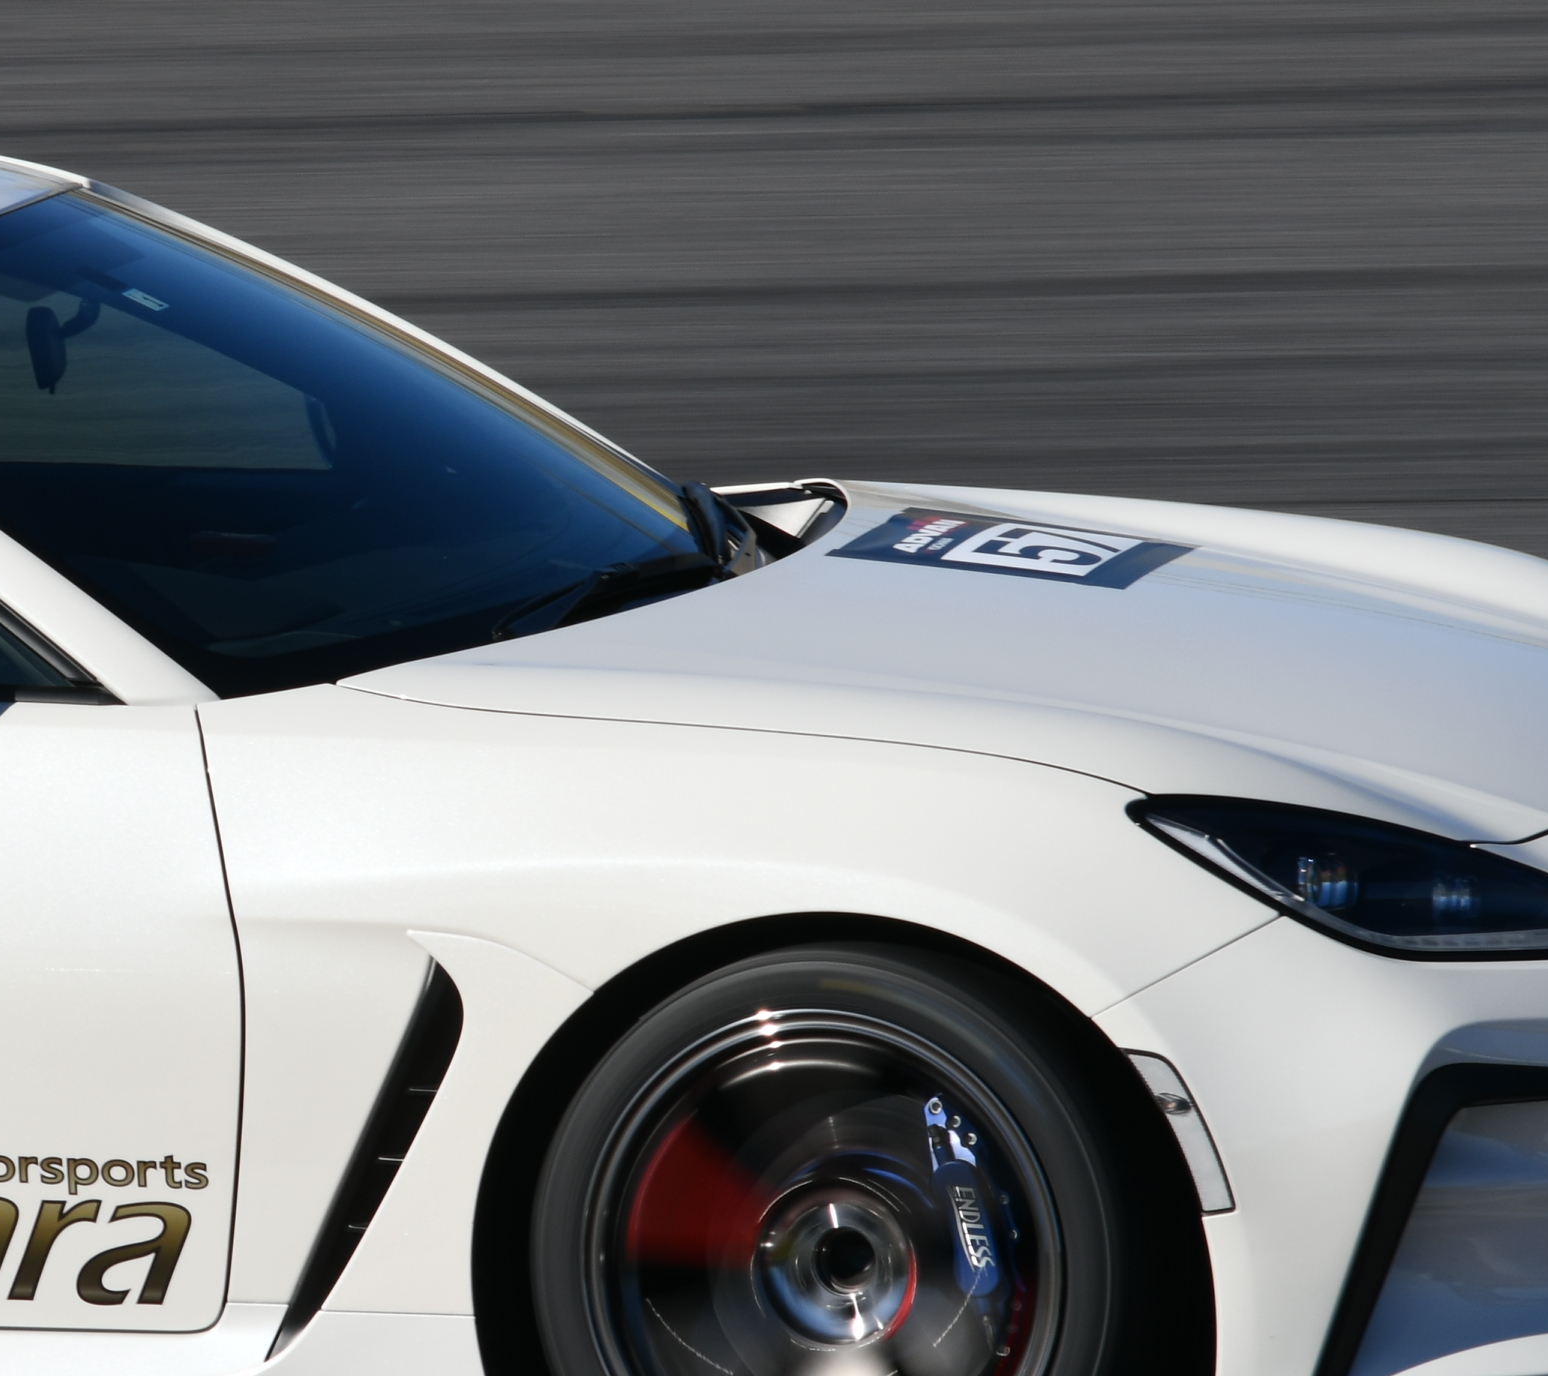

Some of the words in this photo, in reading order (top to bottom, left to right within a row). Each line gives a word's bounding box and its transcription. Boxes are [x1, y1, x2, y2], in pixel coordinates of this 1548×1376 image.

[892, 519, 966, 553] ADVAN
[972, 528, 1121, 565] 57
[955, 1186, 996, 1268] ENDLESS
